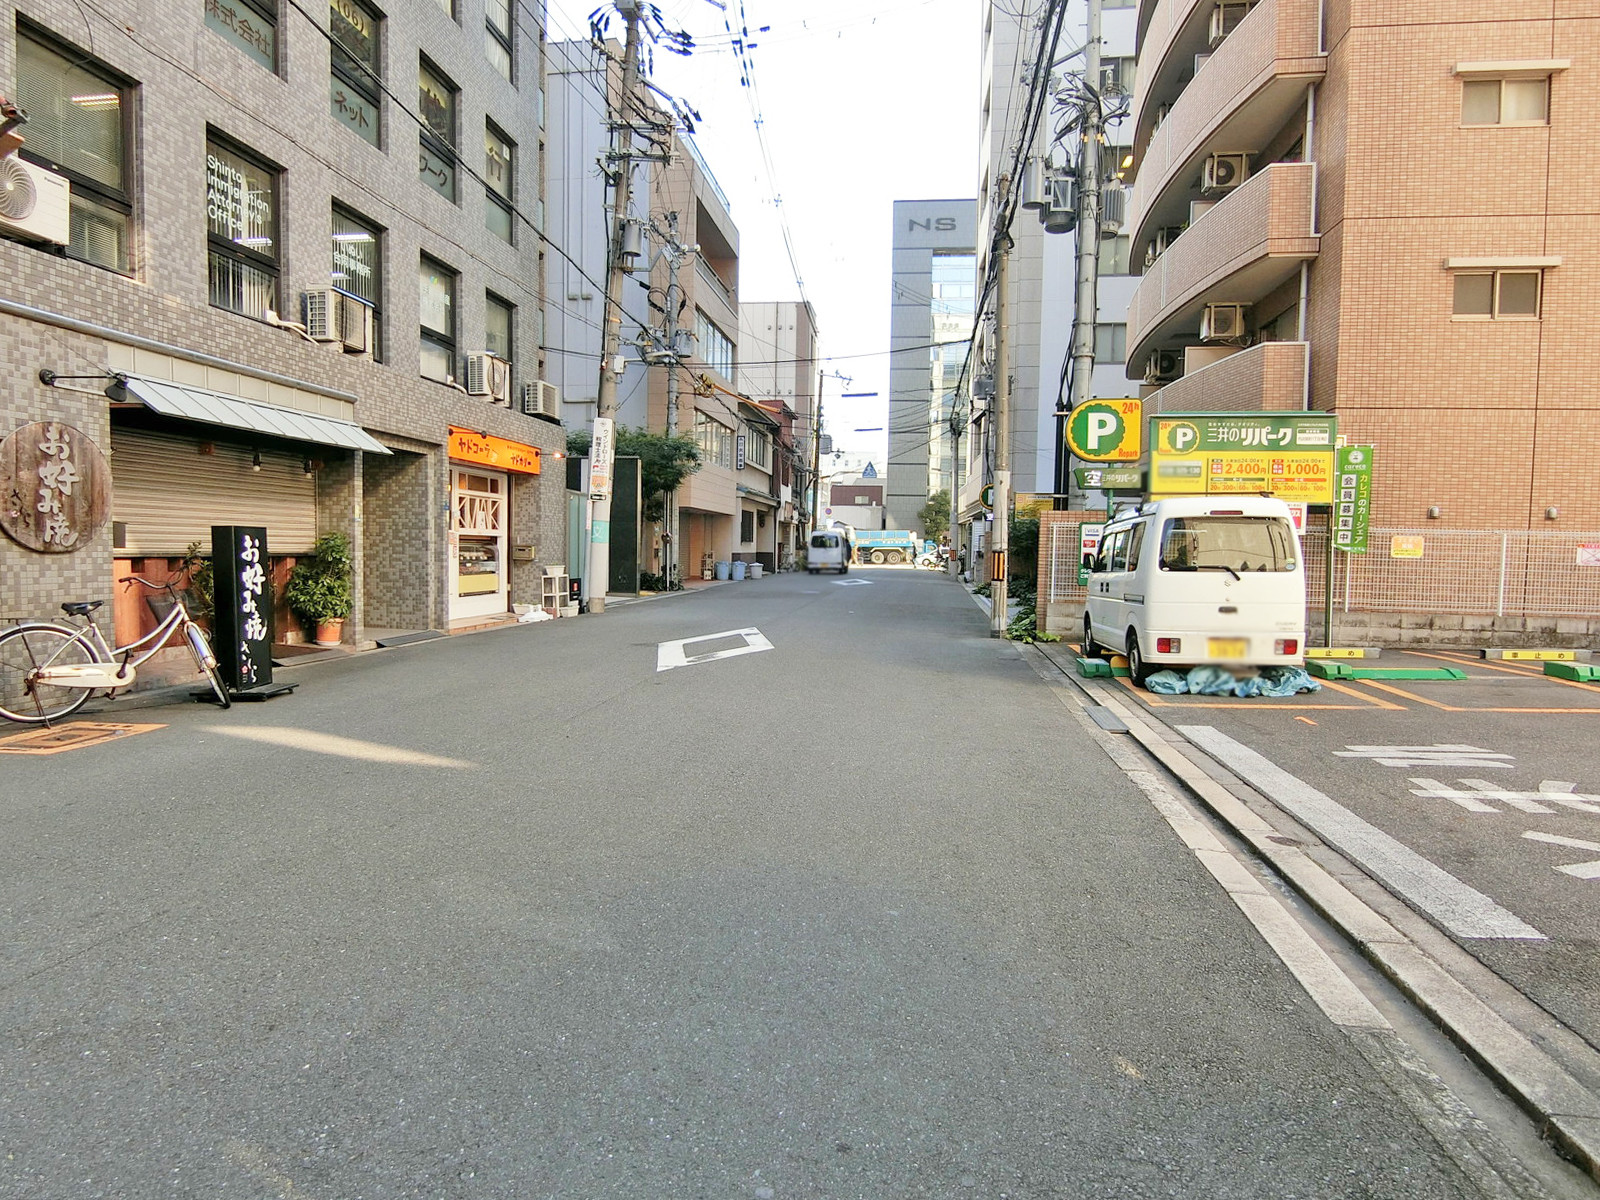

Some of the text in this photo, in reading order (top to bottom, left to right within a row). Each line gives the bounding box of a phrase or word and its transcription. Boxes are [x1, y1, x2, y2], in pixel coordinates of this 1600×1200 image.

[334, 91, 369, 129] ネット
[420, 155, 448, 188] ワーク
[207, 154, 243, 184] Shinto
[207, 204, 243, 231] Office
[908, 217, 957, 232] NS
[1122, 402, 1139, 414] 24h
[1087, 412, 1117, 450] P
[1176, 427, 1194, 449] P
[1207, 426, 1292, 446] 三井のリパーク
[458, 437, 491, 458] ヤドコーラ
[1084, 470, 1102, 487] 空
[1225, 463, 1266, 474] 2,400円
[1286, 463, 1326, 475] 1,000円
[37, 425, 80, 547] お好み焼
[1339, 476, 1354, 541] 会員募集中
[1354, 474, 1368, 544] カレコのカーシェア
[241, 534, 267, 641] お好み焼
